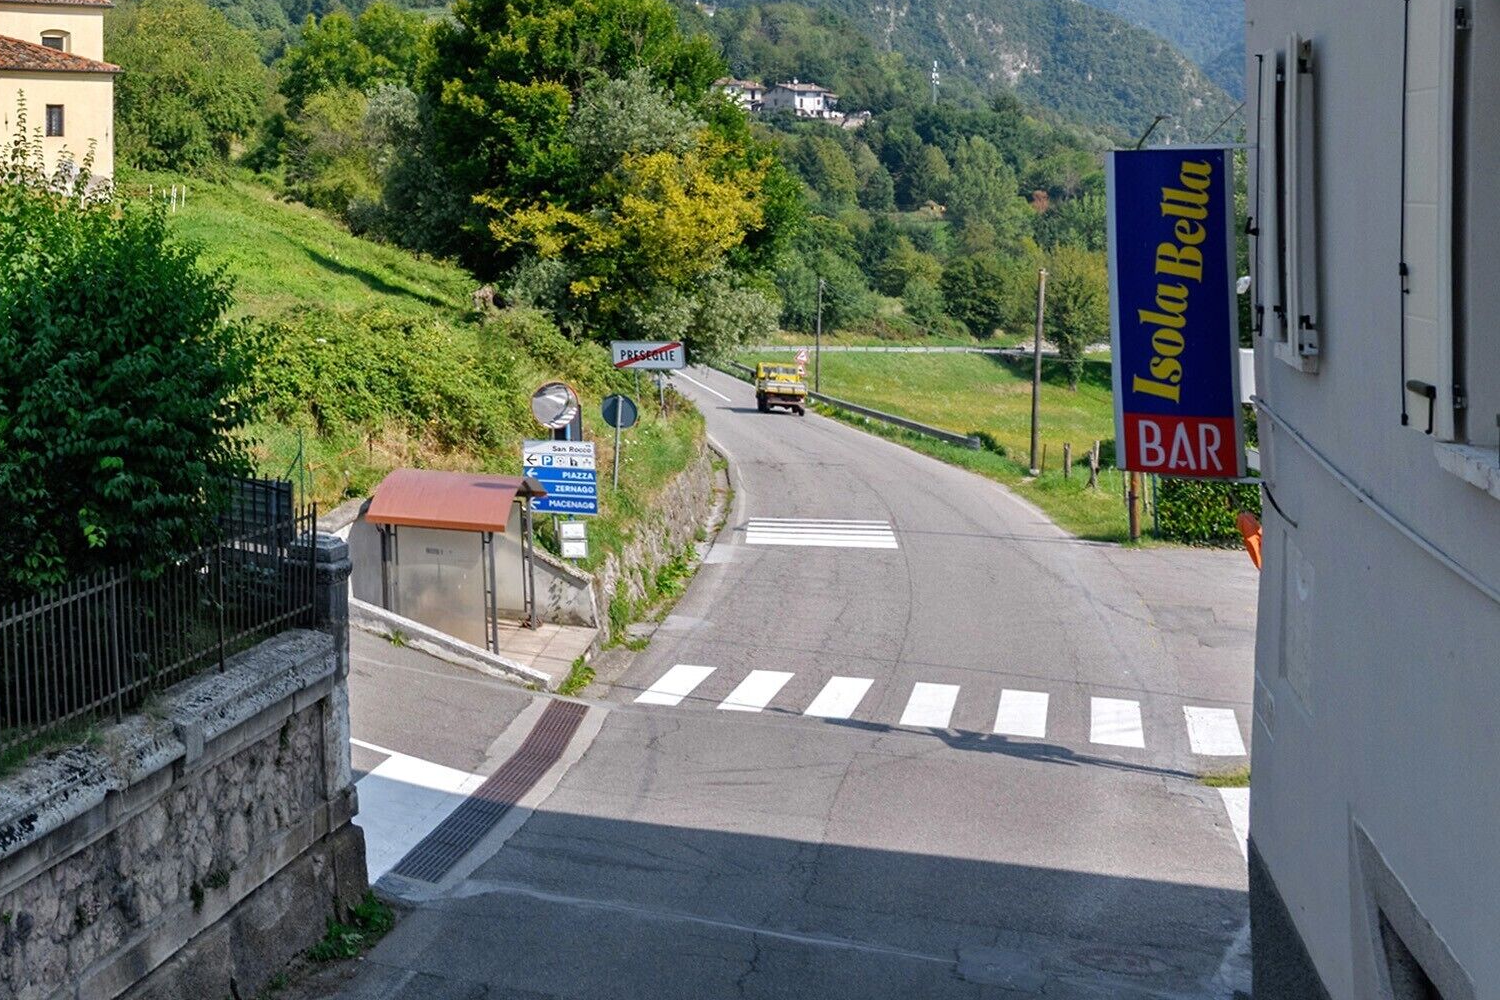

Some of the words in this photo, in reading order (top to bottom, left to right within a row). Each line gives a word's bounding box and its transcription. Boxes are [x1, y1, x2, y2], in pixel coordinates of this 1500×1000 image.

[1155, 159, 1212, 283] Bella
[1132, 282, 1190, 404] Isola
[620, 349, 675, 362] PRESEGLIE
[1138, 419, 1224, 471] BAR
[562, 471, 594, 480] PIAZZA
[555, 485, 595, 493] ZERNAGO
[549, 500, 595, 509] MACENAGO
